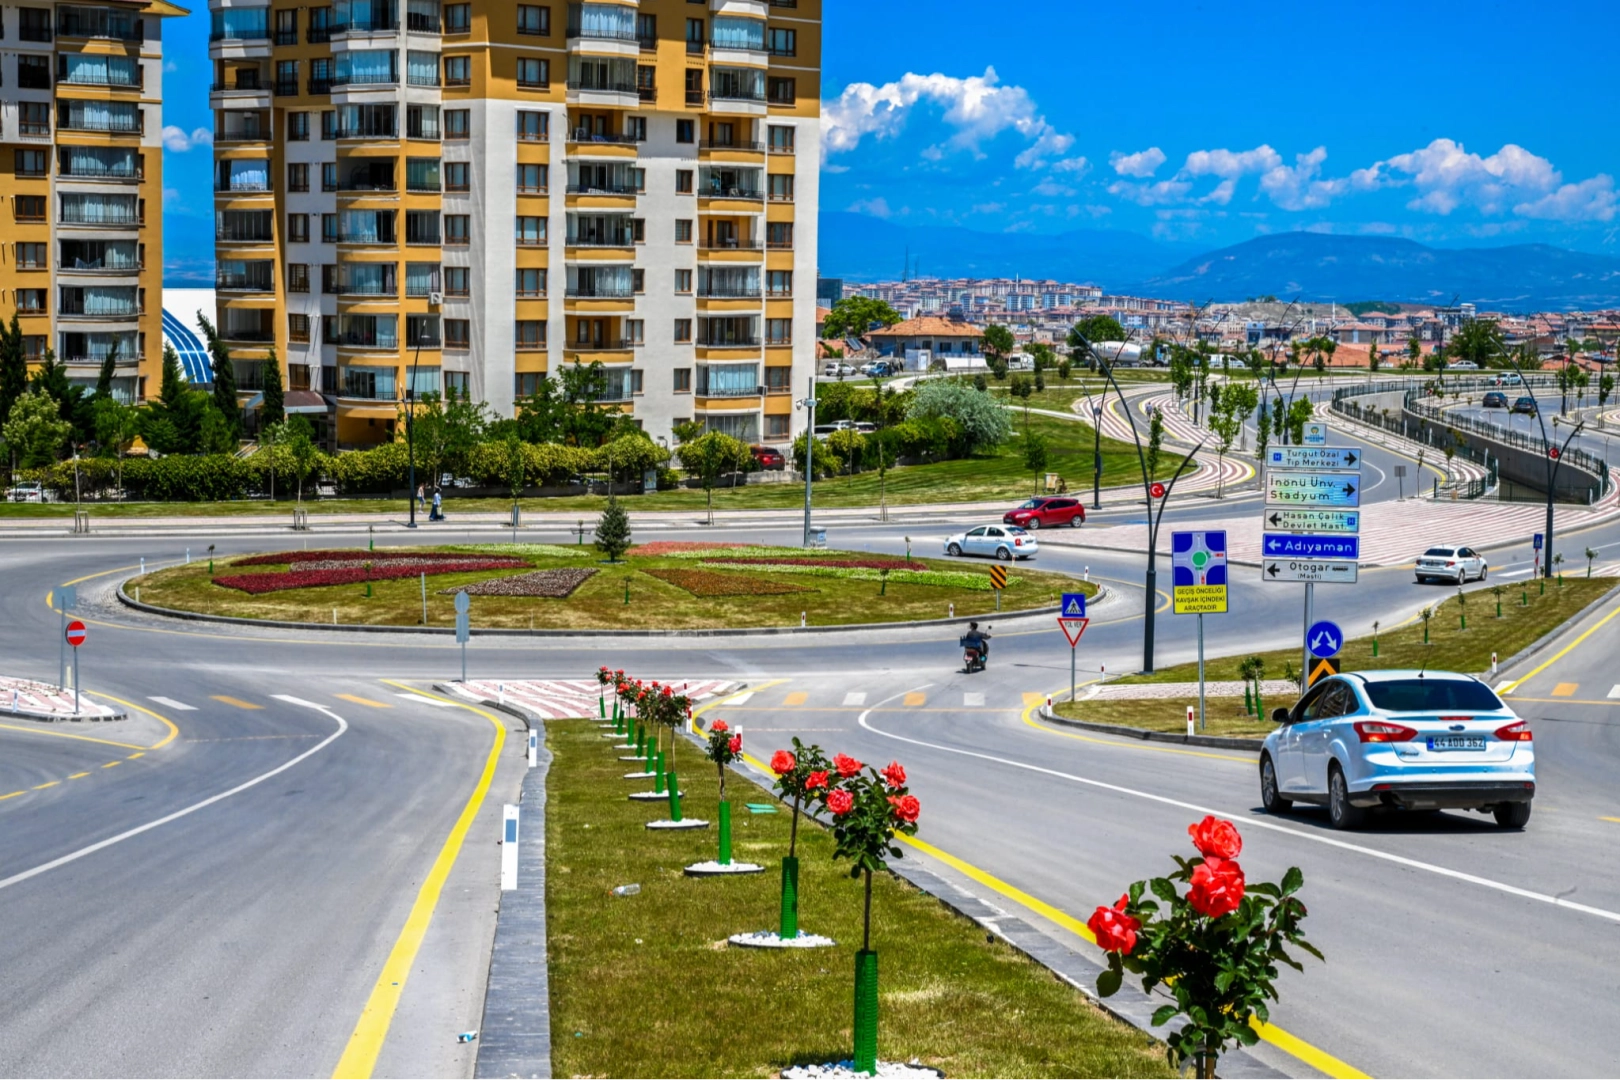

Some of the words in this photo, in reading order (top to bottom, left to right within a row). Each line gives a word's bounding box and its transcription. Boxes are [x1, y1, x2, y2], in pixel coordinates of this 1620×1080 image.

[1287, 450, 1318, 458] Turgut
[1320, 449, 1340, 458] Özal
[1270, 476, 1306, 487] İnönü
[1310, 477, 1336, 488] Ünv.
[1270, 490, 1330, 502] Stadyum
[1284, 540, 1352, 554] Adıyaman
[1290, 562, 1330, 573] Otogar
[1434, 738, 1445, 747] 44
[1467, 738, 1484, 747] 362
